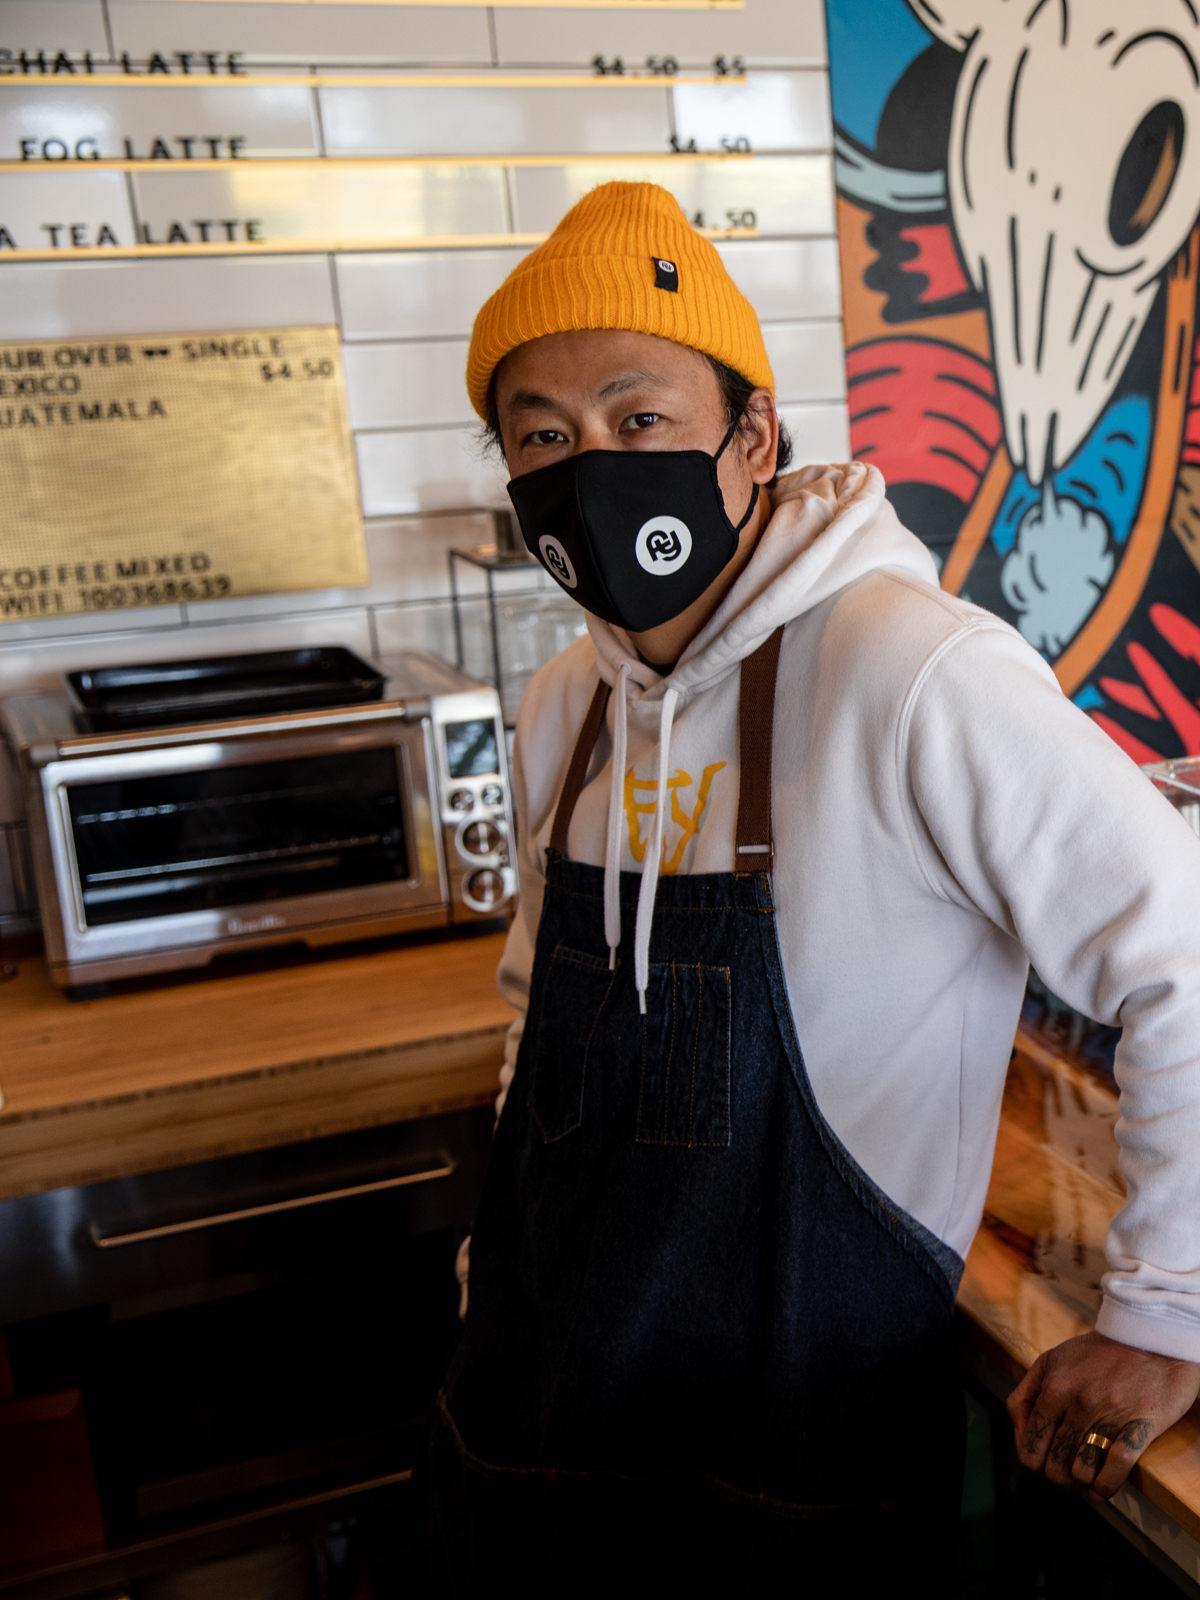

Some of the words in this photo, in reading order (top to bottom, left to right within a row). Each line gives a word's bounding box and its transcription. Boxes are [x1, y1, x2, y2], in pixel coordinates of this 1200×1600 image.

[120, 51, 248, 76] LATTE
[591, 54, 679, 77] $4.50
[713, 54, 745, 77] $5
[20, 137, 100, 161] FOG
[124, 136, 248, 160] LATTE
[682, 208, 756, 229] 4.50
[42, 223, 119, 249] TEA
[141, 218, 265, 245] LATTE
[0, 349, 45, 370] UR
[54, 344, 132, 367] OVER
[182, 336, 282, 362] SINGLE
[116, 552, 210, 579] MIXED
[1, 590, 63, 614] WIFI
